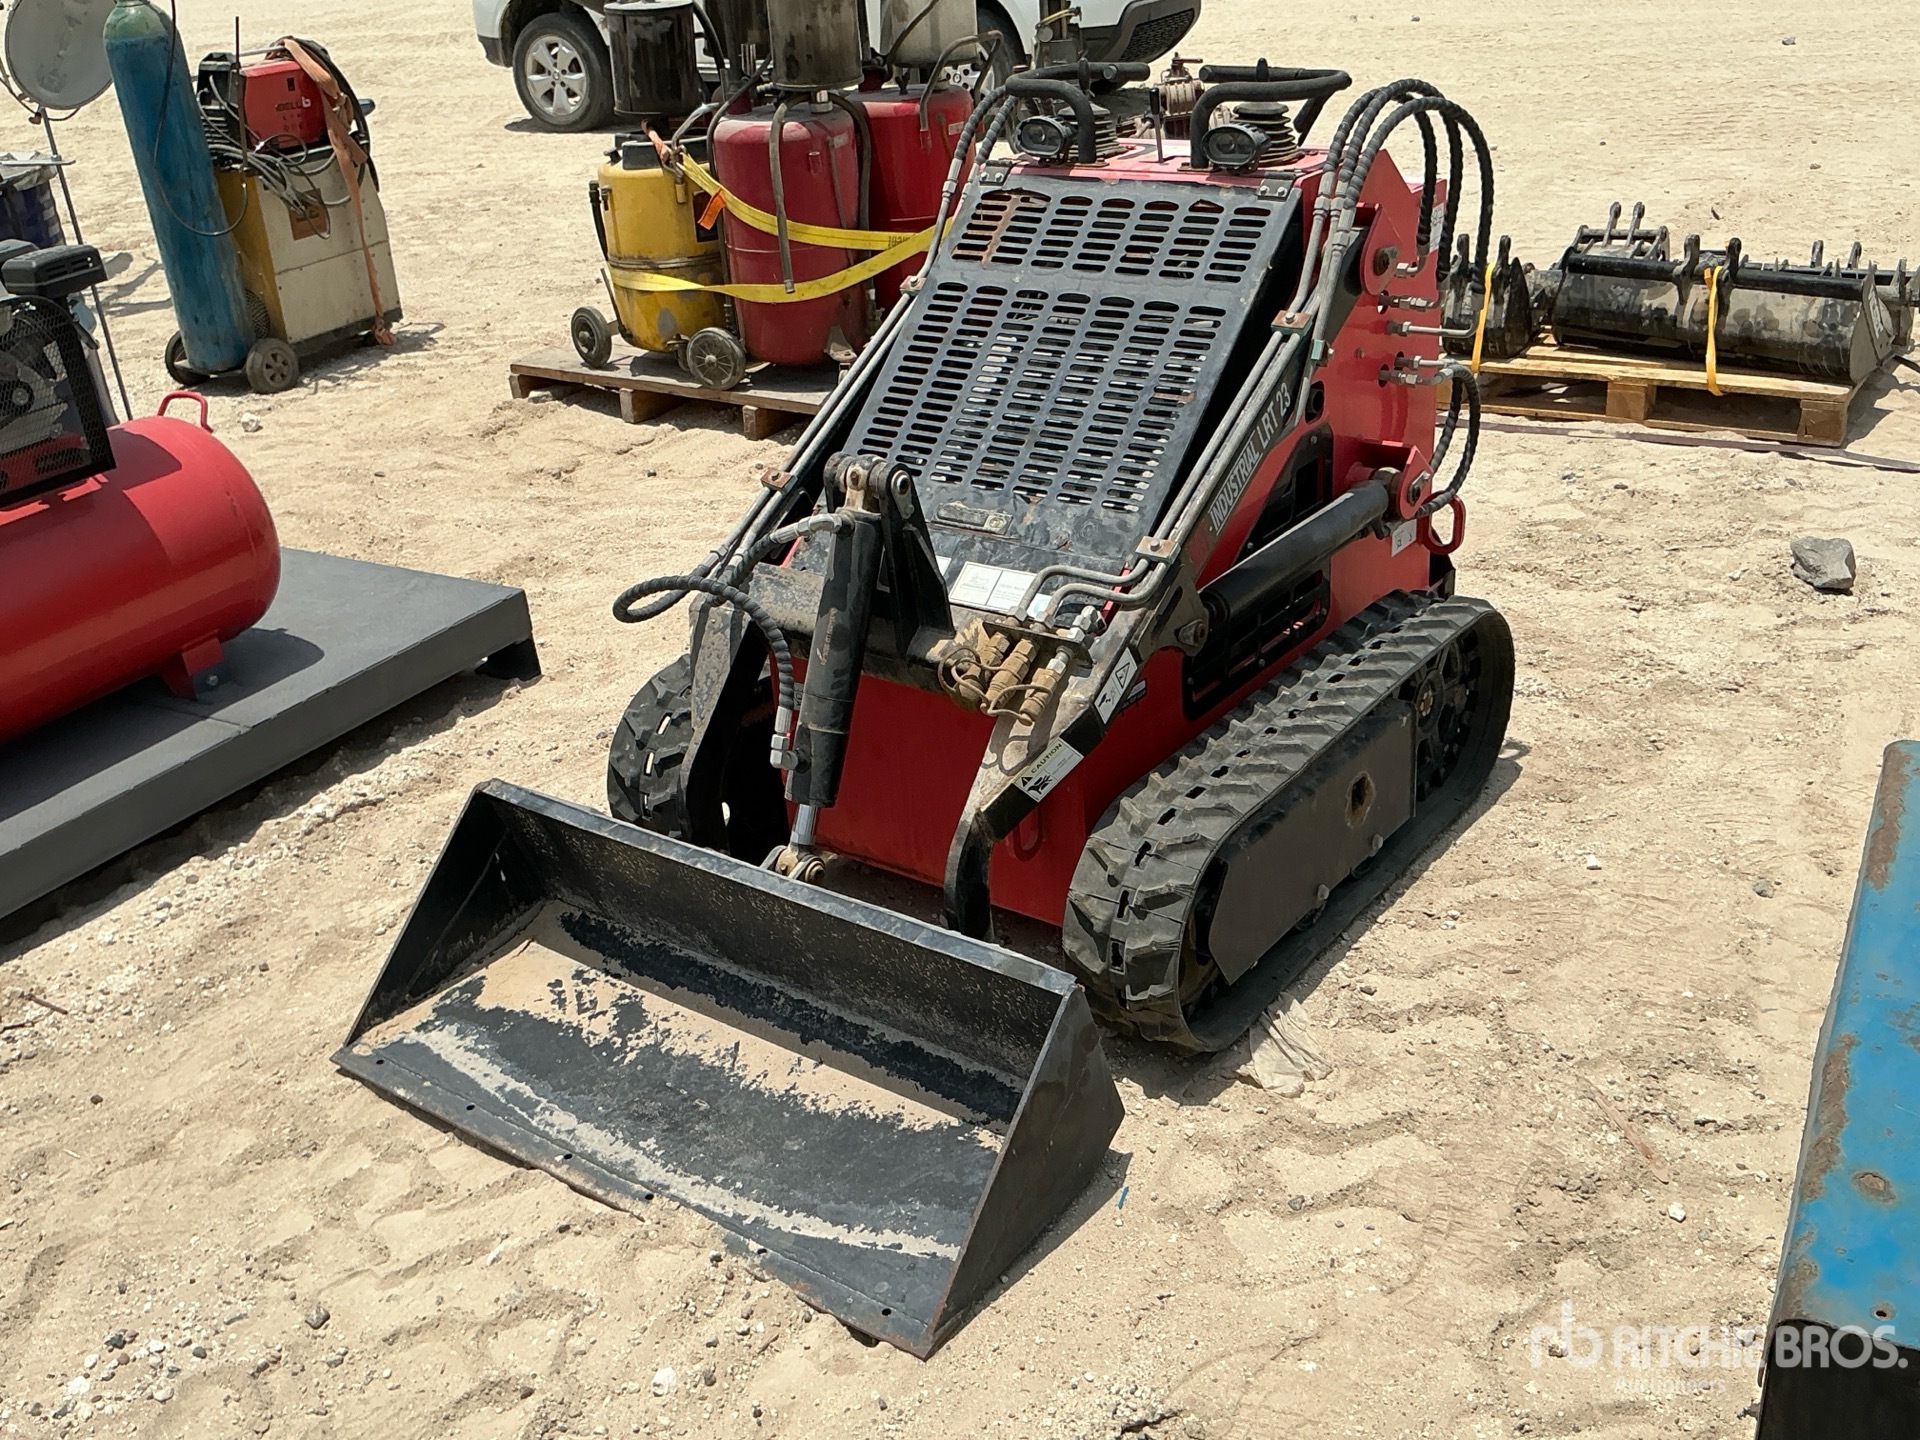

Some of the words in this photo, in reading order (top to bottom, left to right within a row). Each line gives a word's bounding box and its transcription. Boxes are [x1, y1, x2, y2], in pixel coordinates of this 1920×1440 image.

[1209, 440, 1260, 532] INDUSTRIAL
[1256, 401, 1278, 450] LRT
[1276, 382, 1291, 417] 23
[1031, 743, 1063, 774] CAUTION
